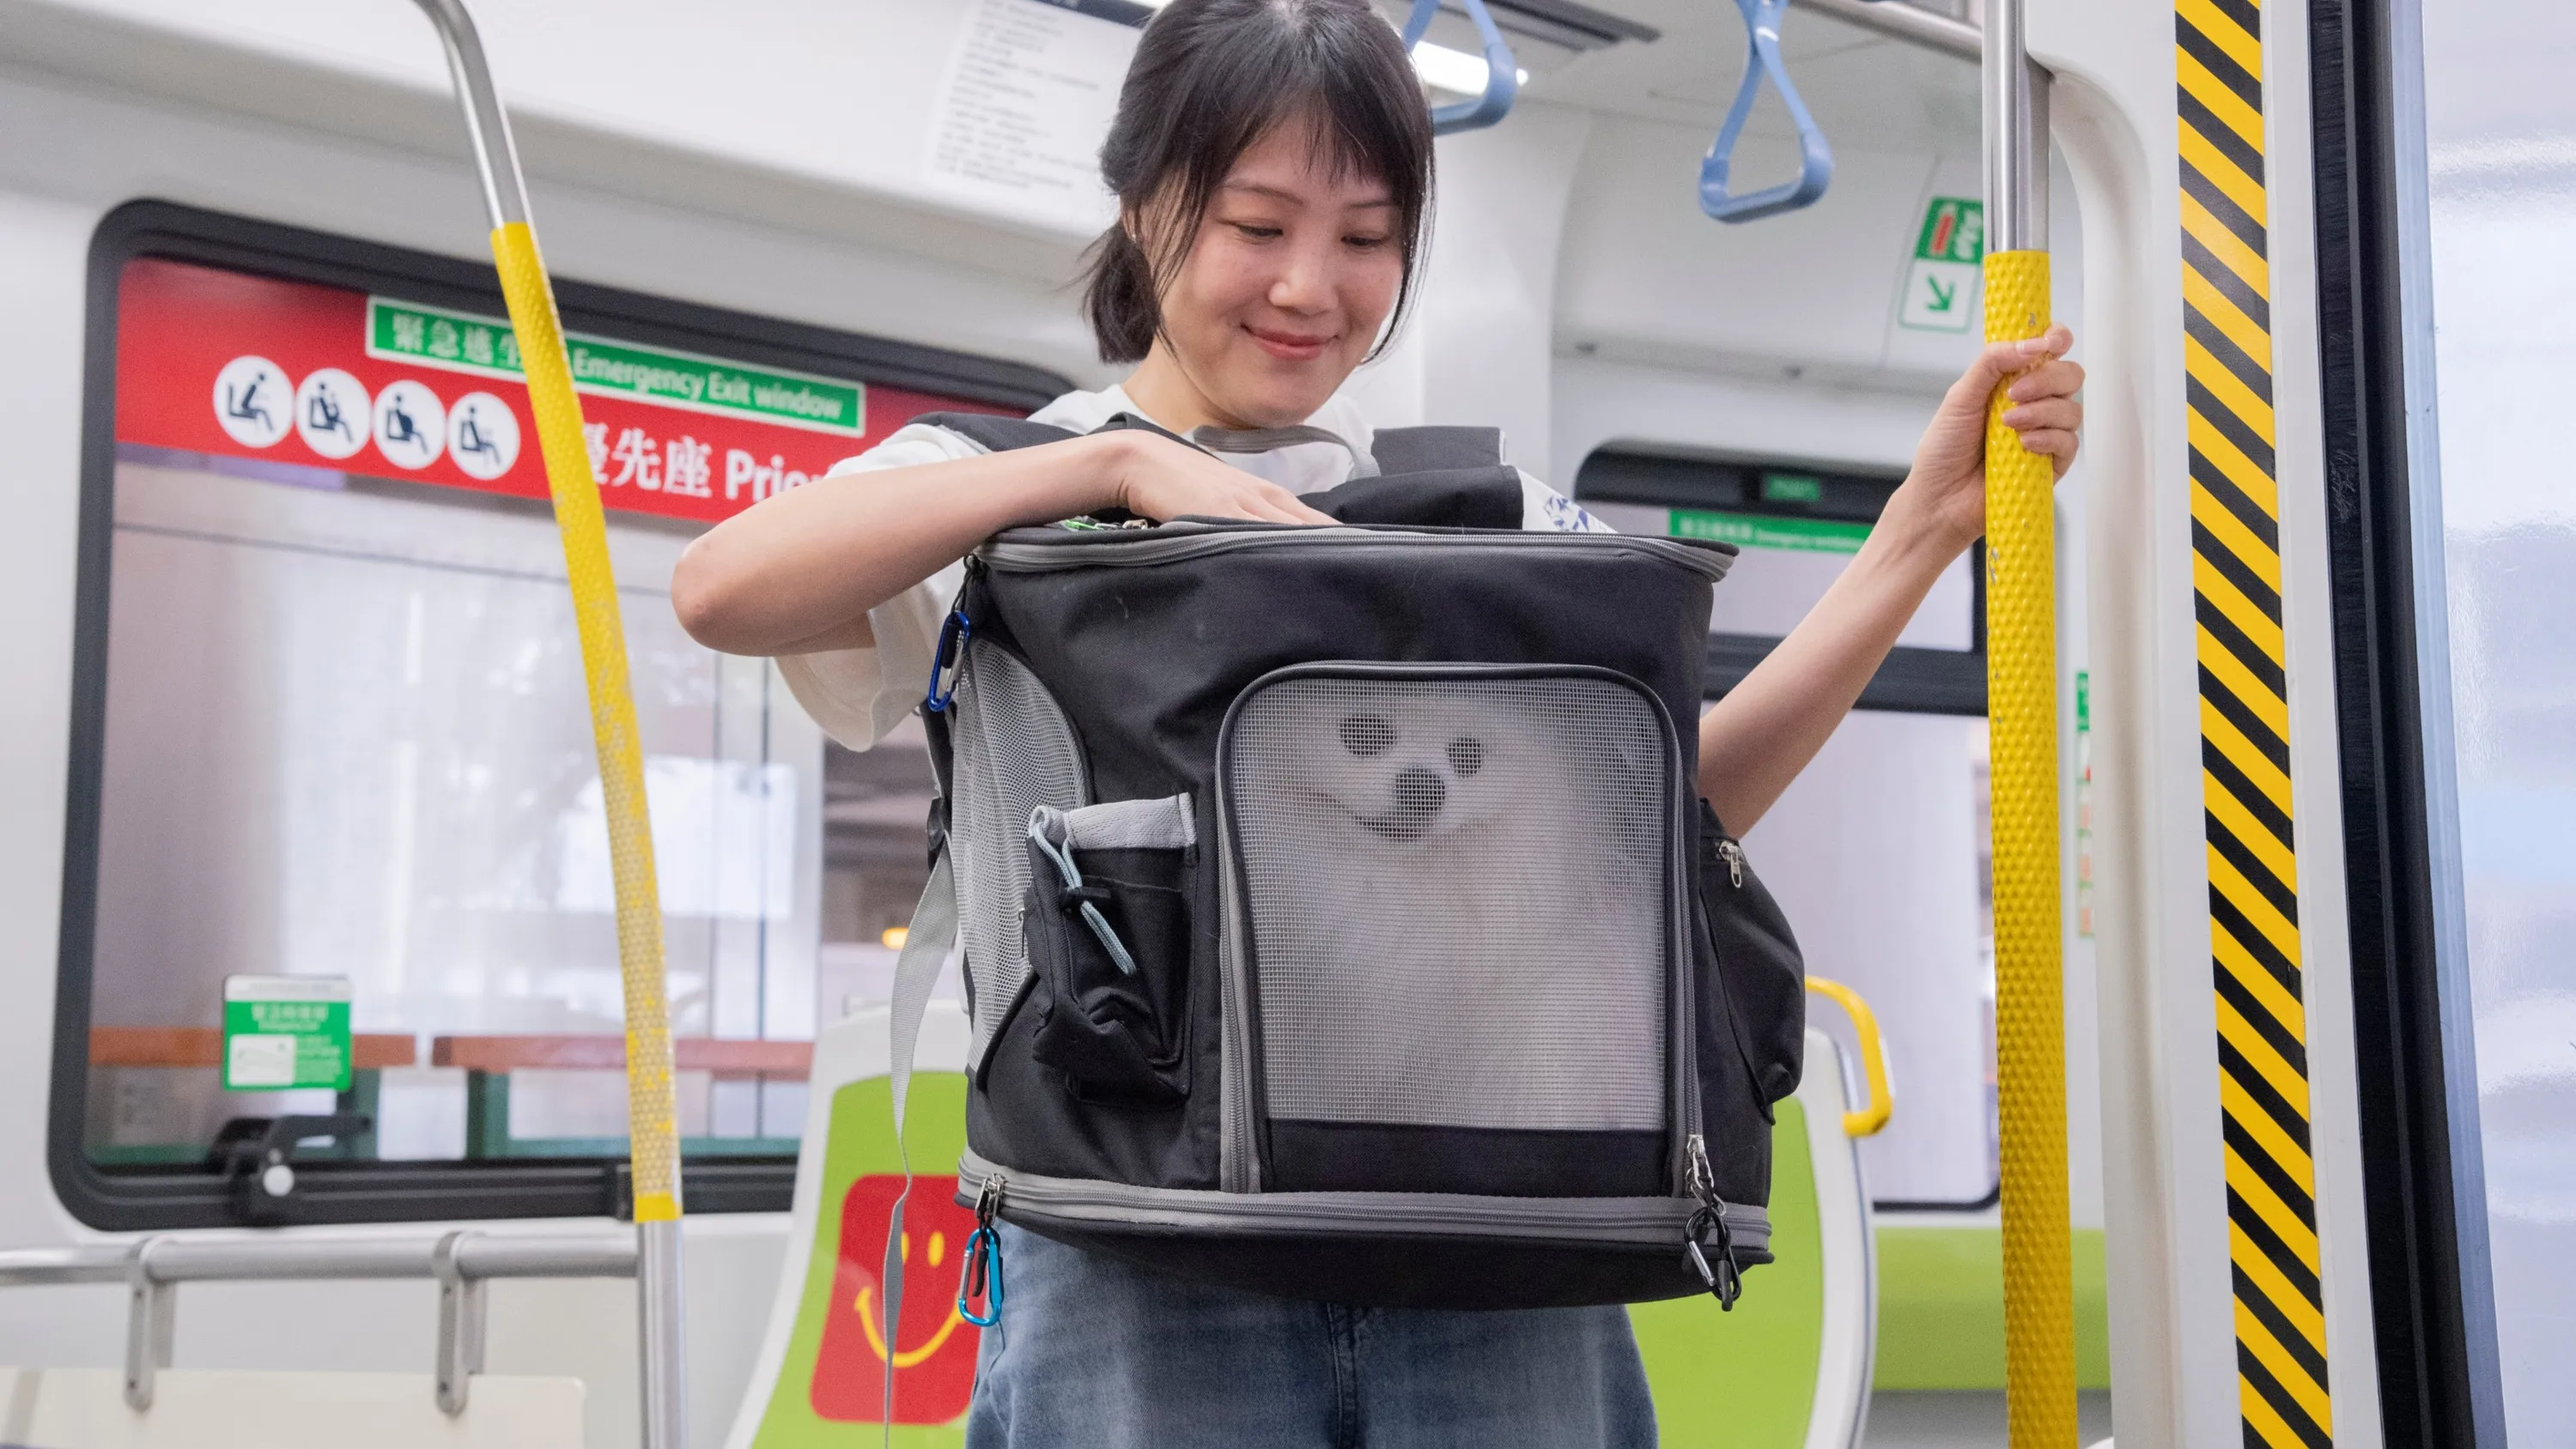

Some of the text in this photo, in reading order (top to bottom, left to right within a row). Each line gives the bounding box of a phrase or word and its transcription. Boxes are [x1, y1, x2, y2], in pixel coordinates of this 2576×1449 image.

[573, 347, 705, 402] Emergency
[708, 371, 751, 405] Exit
[753, 385, 842, 420] window
